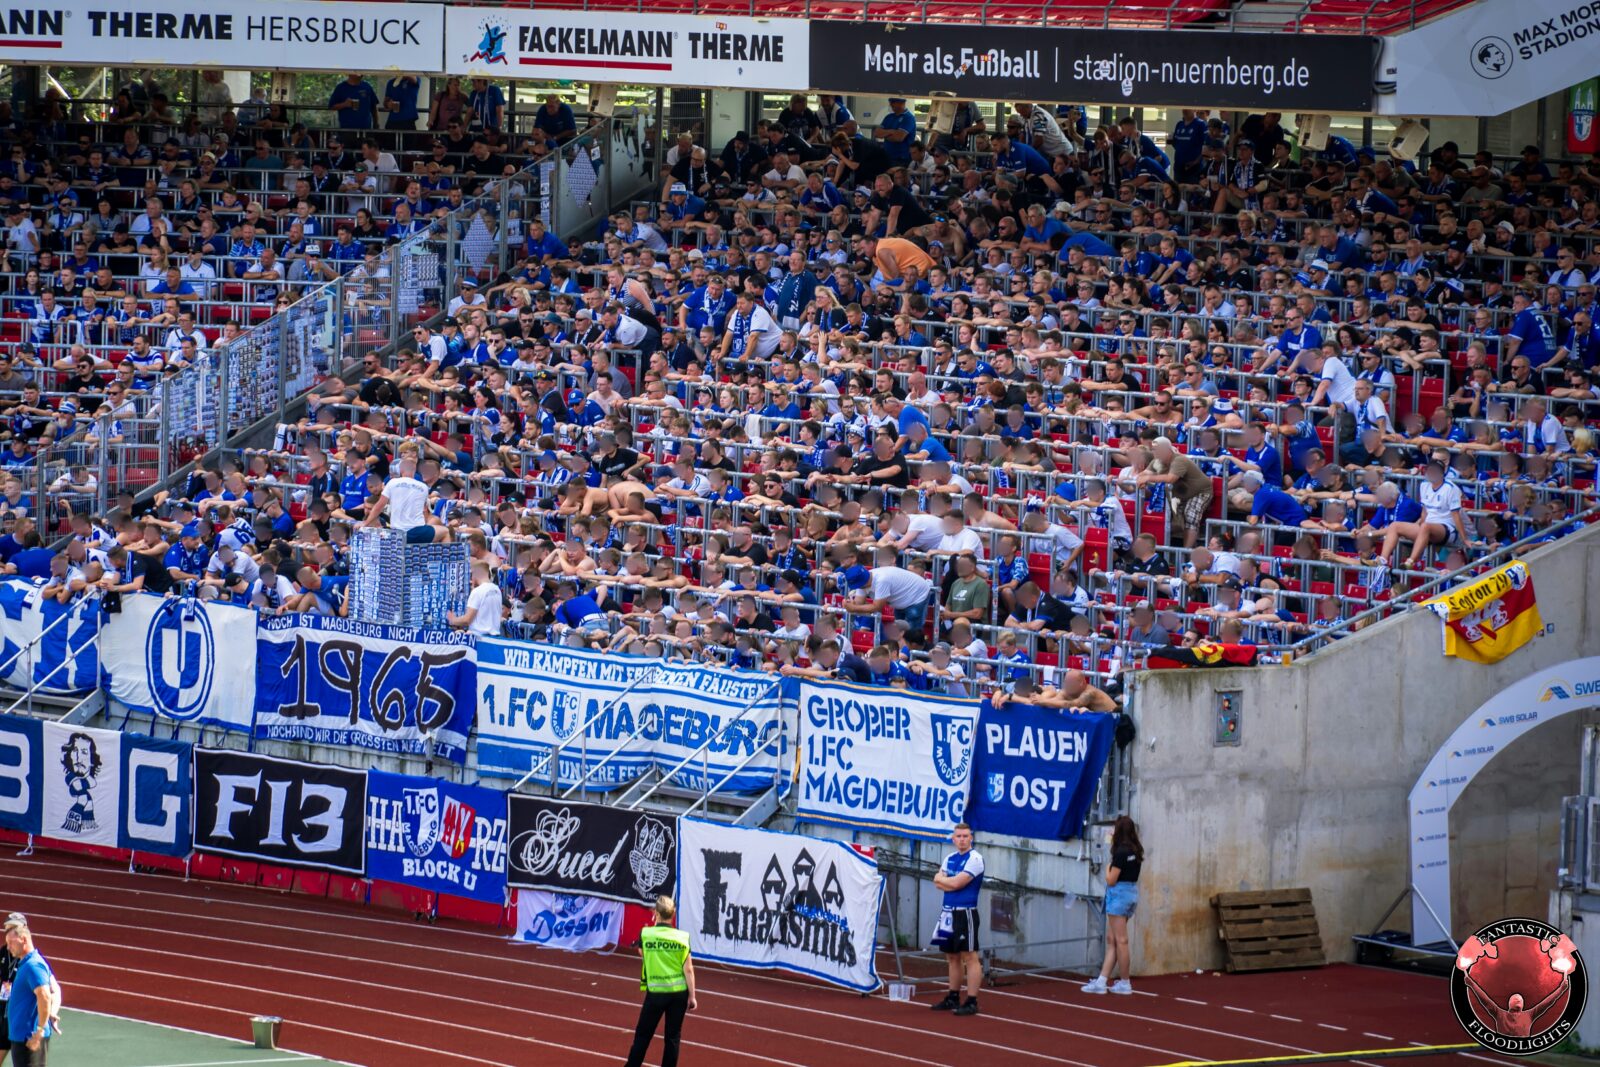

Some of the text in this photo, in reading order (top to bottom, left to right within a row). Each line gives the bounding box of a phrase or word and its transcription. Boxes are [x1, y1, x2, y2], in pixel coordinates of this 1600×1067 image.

[88, 10, 233, 40] THERME
[247, 15, 421, 46] HERSBRUCK
[519, 26, 784, 63] FACKELMANN THERME
[1513, 21, 1557, 46] MAX
[864, 43, 918, 73] Mehr
[923, 47, 954, 76] als
[1073, 52, 1310, 93] stadion-nuernberg.de
[268, 616, 476, 647] NOCH IST MAGDEBURG NICHT VERLOREN
[504, 648, 530, 668] WIR
[533, 651, 598, 679] KÄMPFEN
[600, 662, 624, 682] MIT
[278, 634, 467, 733] 1965
[483, 684, 547, 731] 1.FC
[554, 693, 578, 710] 1.FC
[1515, 711, 1538, 722] SOLAR
[267, 726, 295, 738] NOCH
[315, 729, 331, 742] WIR
[333, 732, 348, 744] DIE
[935, 722, 970, 745] 1.FC
[985, 723, 1088, 763] PLAUEN
[807, 734, 854, 770] 1.FC
[936, 746, 969, 779] MAGDEBURG
[560, 760, 616, 783] UNSERE
[805, 769, 964, 823] MAGDEBURG
[1010, 774, 1066, 811] OST
[402, 858, 478, 891] BLOCK U
